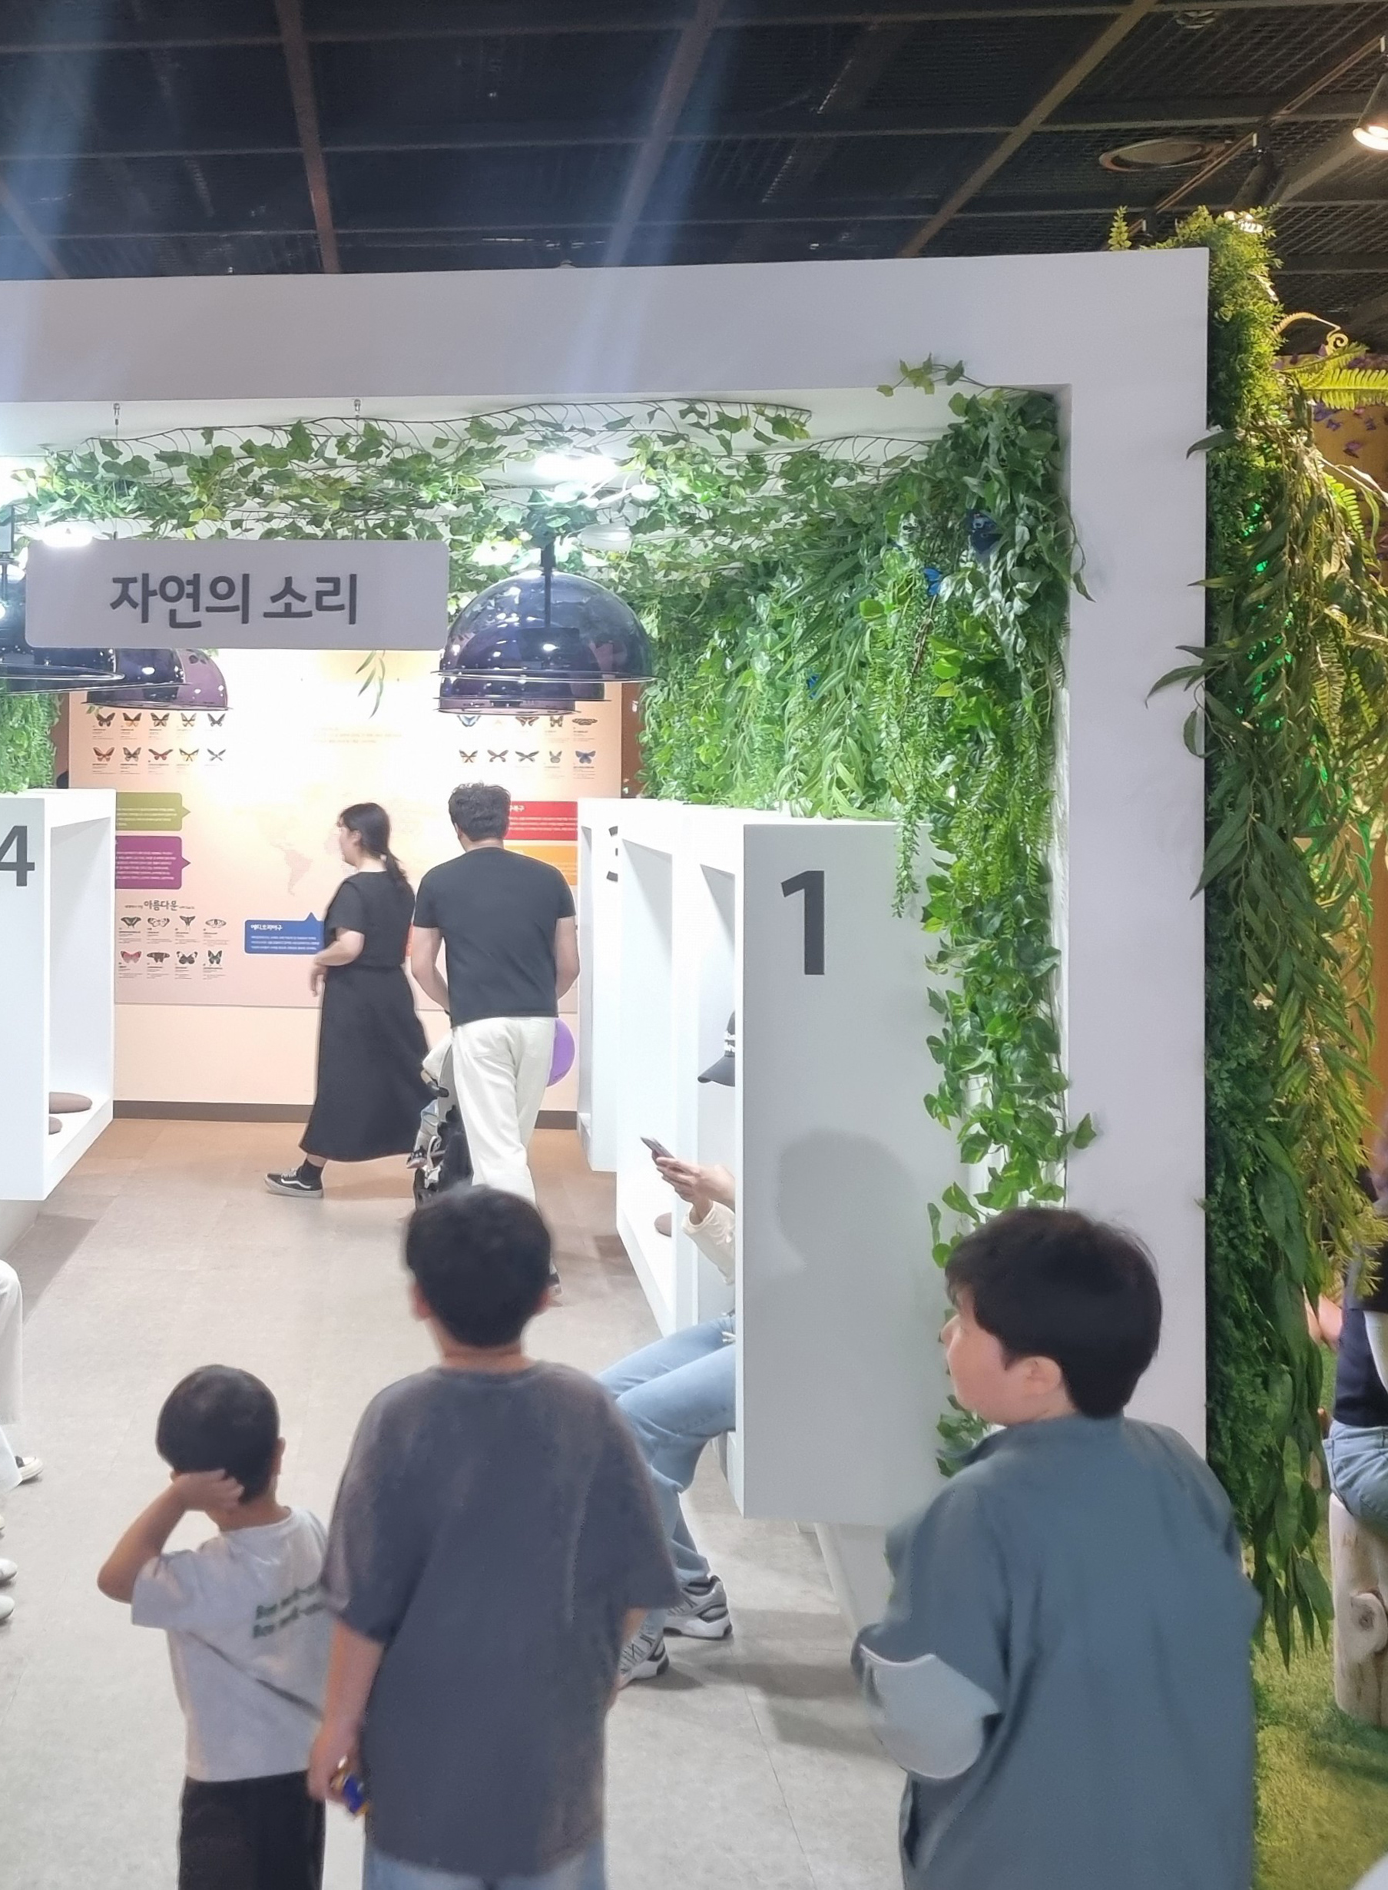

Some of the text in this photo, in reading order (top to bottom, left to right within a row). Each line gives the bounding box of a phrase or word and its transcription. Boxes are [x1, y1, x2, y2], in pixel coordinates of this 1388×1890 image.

[109, 572, 358, 629] 자연의 소리
[143, 899, 179, 911] 아름다운
[780, 870, 825, 976] 1
